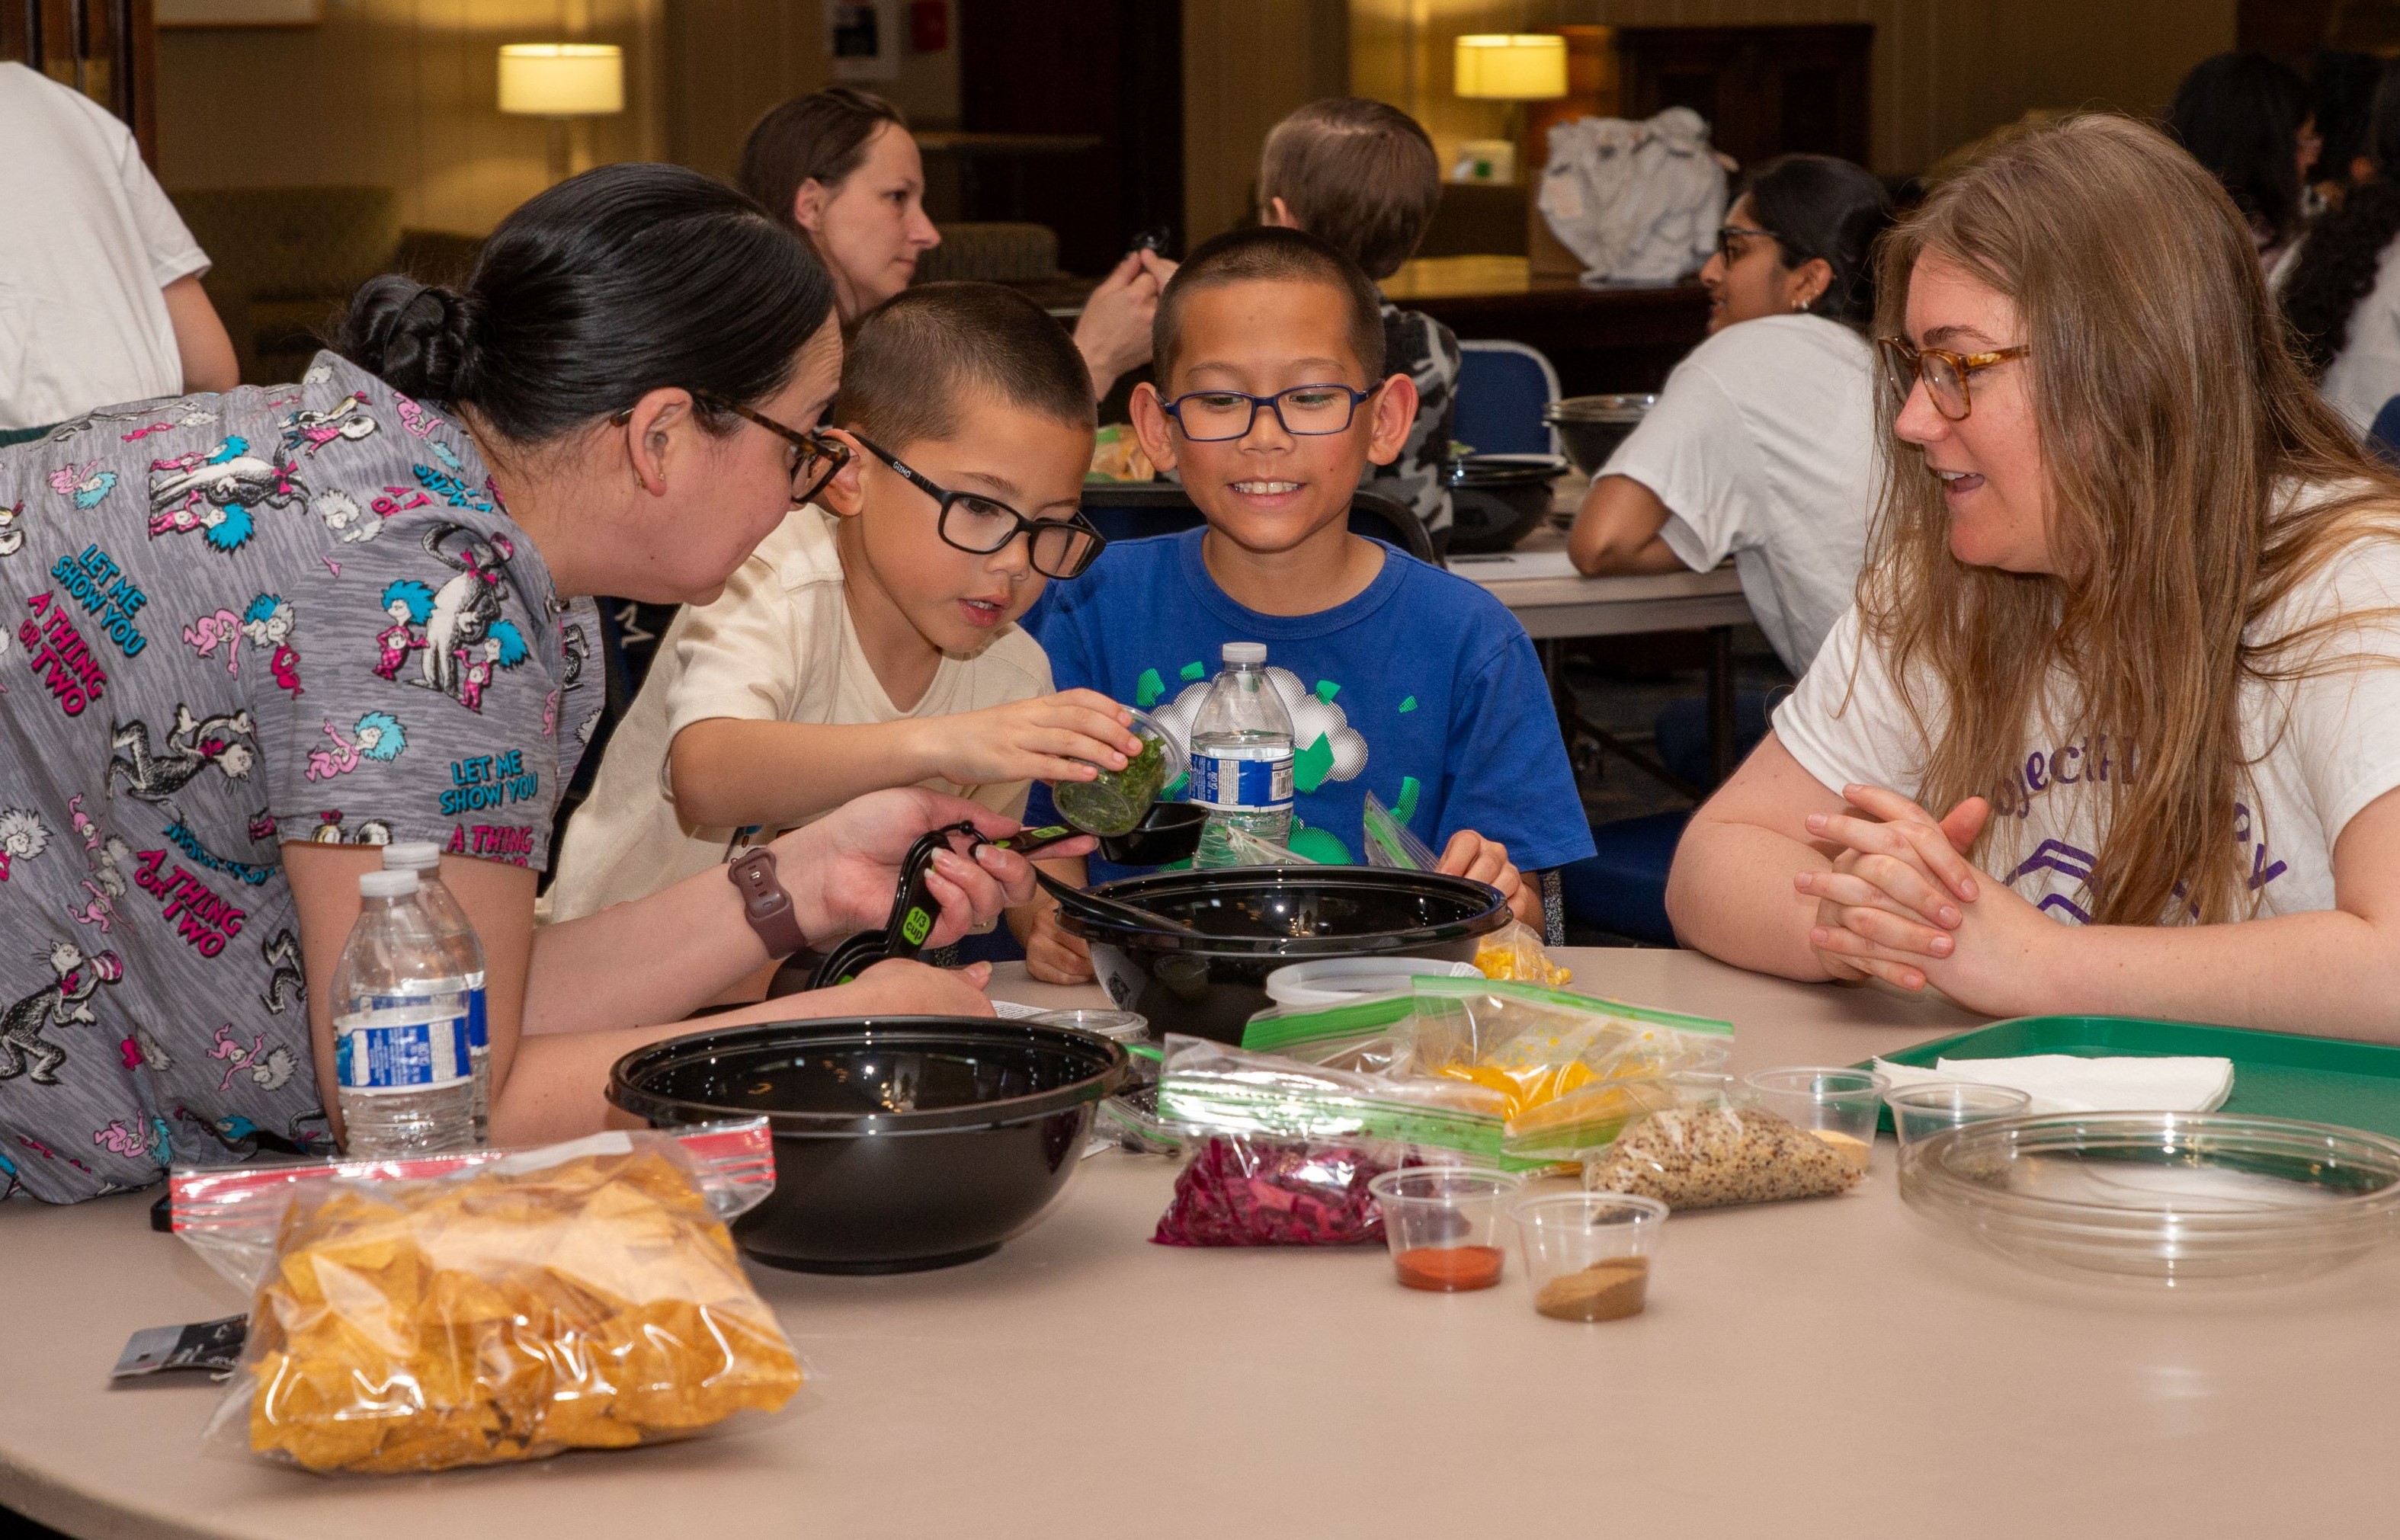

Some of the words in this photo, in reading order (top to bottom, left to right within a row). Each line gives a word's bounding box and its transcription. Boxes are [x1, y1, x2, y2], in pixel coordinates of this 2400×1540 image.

[383, 486, 414, 497] A
[51, 555, 107, 615] SHOW
[101, 604, 146, 657] YOU
[79, 543, 120, 586] LET
[108, 576, 147, 618] ME
[18, 619, 41, 652] OR
[31, 643, 86, 716] TWO
[27, 590, 53, 616] A
[43, 605, 107, 701] THING
[439, 781, 503, 815] SHOW
[506, 771, 537, 804] YOU
[451, 755, 492, 785] LET
[496, 749, 524, 778] ME
[447, 823, 465, 852] A
[471, 824, 534, 853] THING
[134, 867, 168, 901] OR
[162, 898, 226, 958] TWO
[136, 849, 167, 874] A
[165, 865, 246, 938] THING
[914, 911, 927, 927] 1/3
[906, 921, 922, 940] cup
